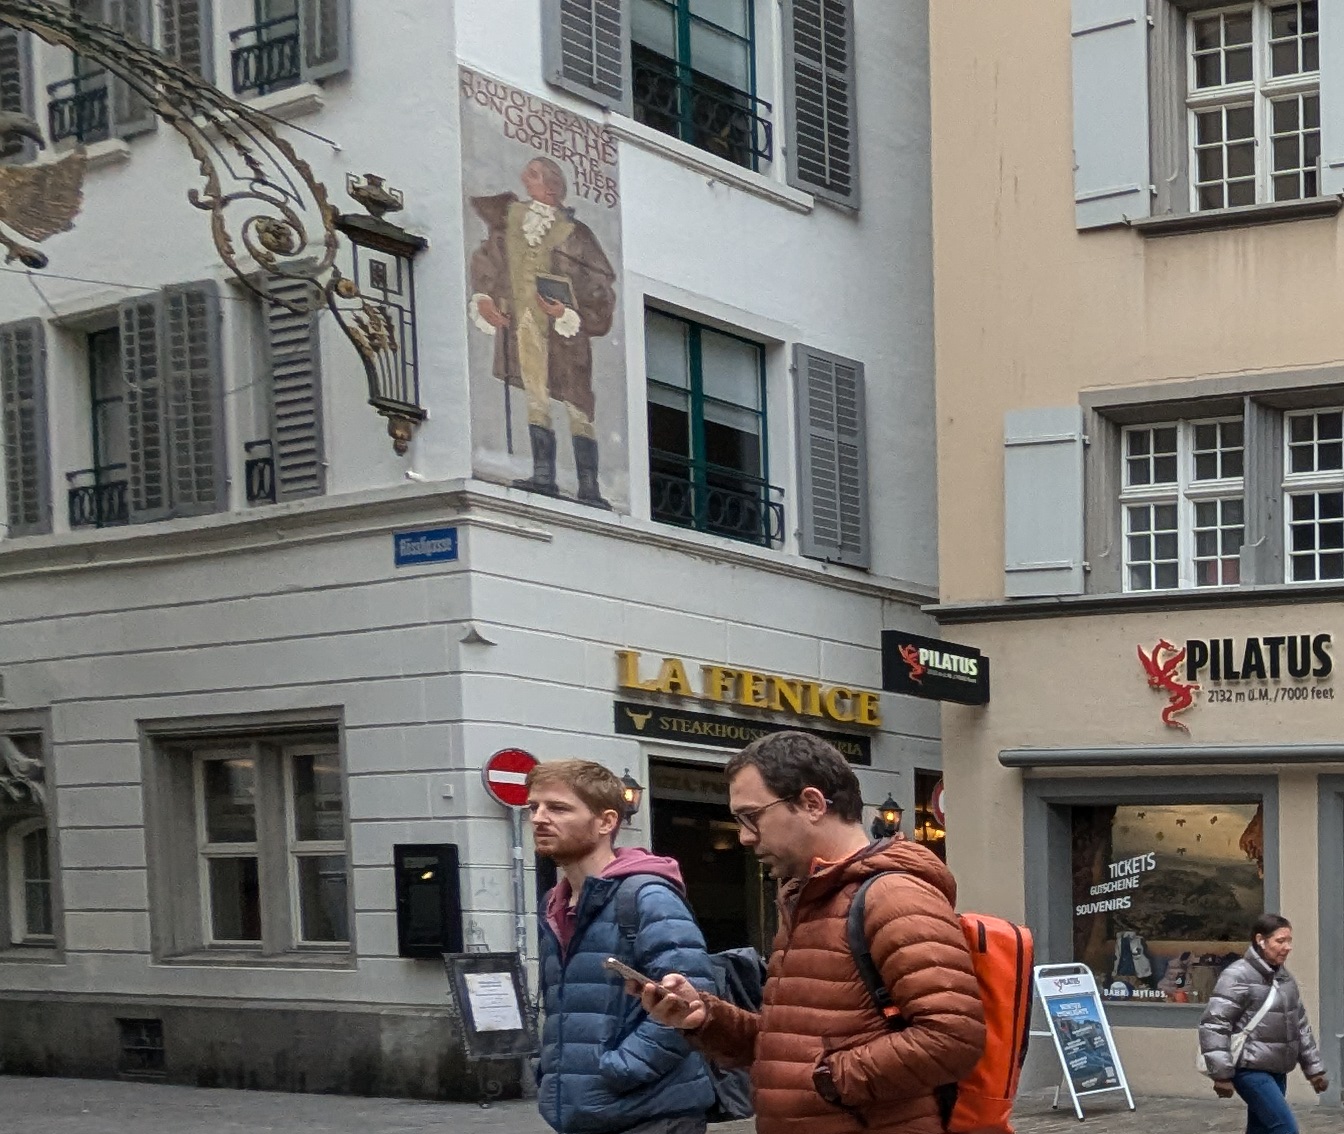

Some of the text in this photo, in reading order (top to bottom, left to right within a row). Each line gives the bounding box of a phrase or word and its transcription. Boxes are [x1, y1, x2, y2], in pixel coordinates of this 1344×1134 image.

[504, 105, 618, 166] GOETHE
[504, 121, 602, 173] LOGIERTE
[573, 181, 617, 209] 1779
[574, 166, 620, 198] HIER
[918, 647, 978, 676] PILATUS
[1186, 633, 1333, 681] PILATUS
[615, 650, 882, 727] LA FENICE
[1207, 689, 1233, 703] 2132
[1235, 691, 1245, 703] m
[1311, 686, 1334, 700] feet
[1108, 851, 1156, 879] TICKETS
[1090, 875, 1140, 896] GUTSCHEINE
[1075, 895, 1131, 916] SOUVENIRS
